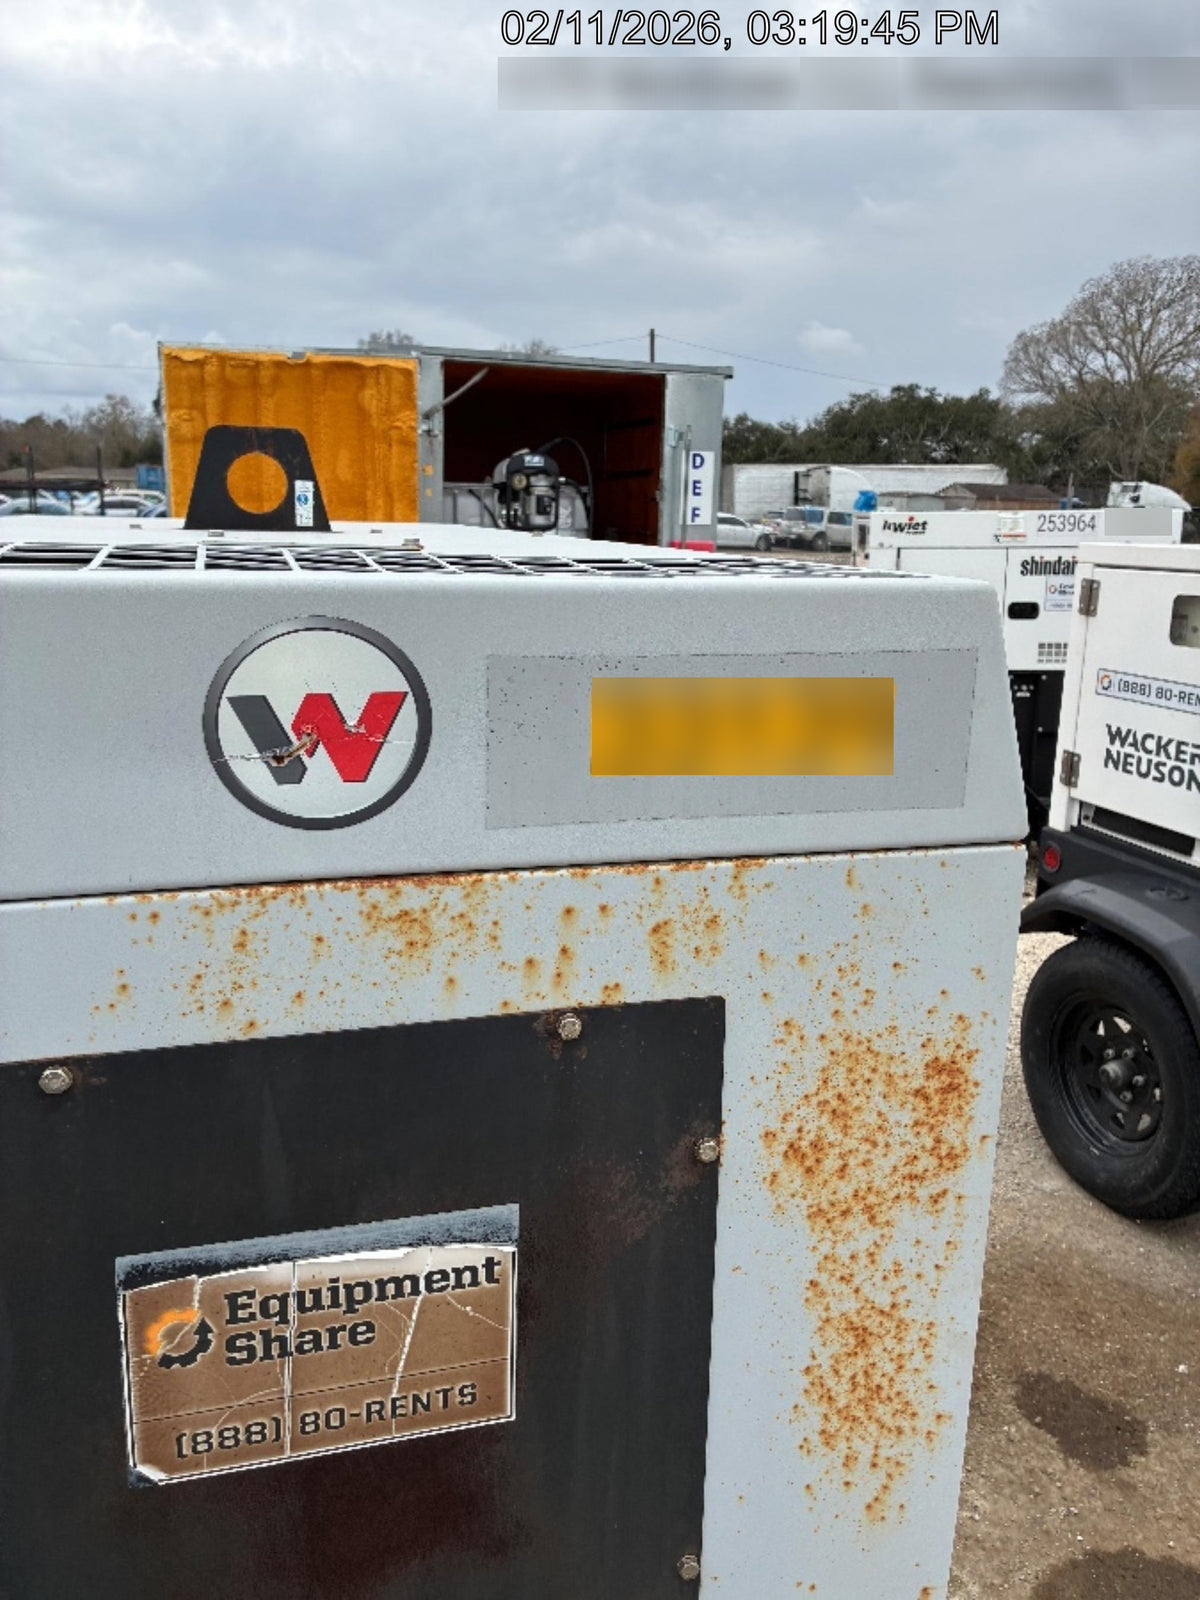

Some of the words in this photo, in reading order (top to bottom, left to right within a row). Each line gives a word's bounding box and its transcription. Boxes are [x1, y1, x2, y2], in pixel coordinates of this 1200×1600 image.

[1037, 514, 1096, 532] 253964
[1118, 679, 1151, 697] (888)
[1104, 747, 1200, 795] NEUSON
[224, 1256, 502, 1326] Equipment
[225, 1319, 377, 1366] Share
[176, 1417, 282, 1459] (888)
[299, 1383, 479, 1436] 80-RENTS
